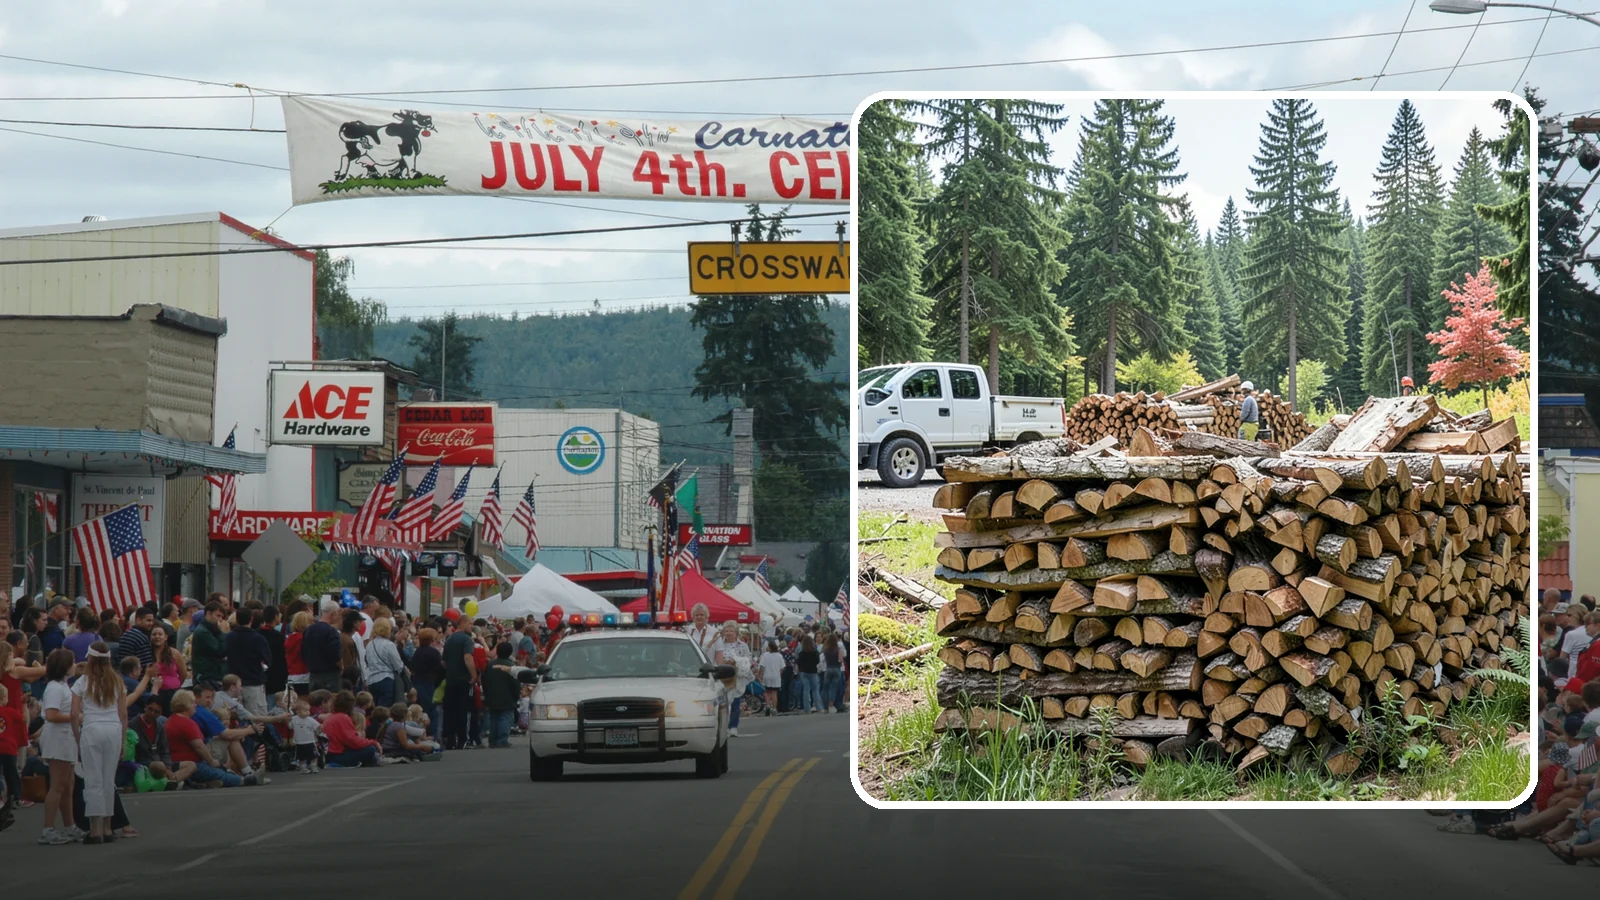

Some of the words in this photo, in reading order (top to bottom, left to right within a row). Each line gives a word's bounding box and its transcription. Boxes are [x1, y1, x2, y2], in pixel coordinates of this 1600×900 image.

[481, 141, 605, 192] JULY
[632, 150, 746, 197] 4th.
[697, 253, 850, 280] CROSSWA
[283, 380, 374, 420] ACE
[405, 409, 452, 422] CEDAR
[283, 421, 371, 437] Hardware
[416, 428, 478, 447] Coca-Cola
[353, 467, 386, 480] Simpl
[83, 484, 94, 494] St.
[95, 485, 124, 495] Vincent
[126, 486, 136, 495] de
[137, 486, 155, 495] Paul
[688, 526, 742, 535] CRNATION
[699, 535, 730, 543] GLASS
